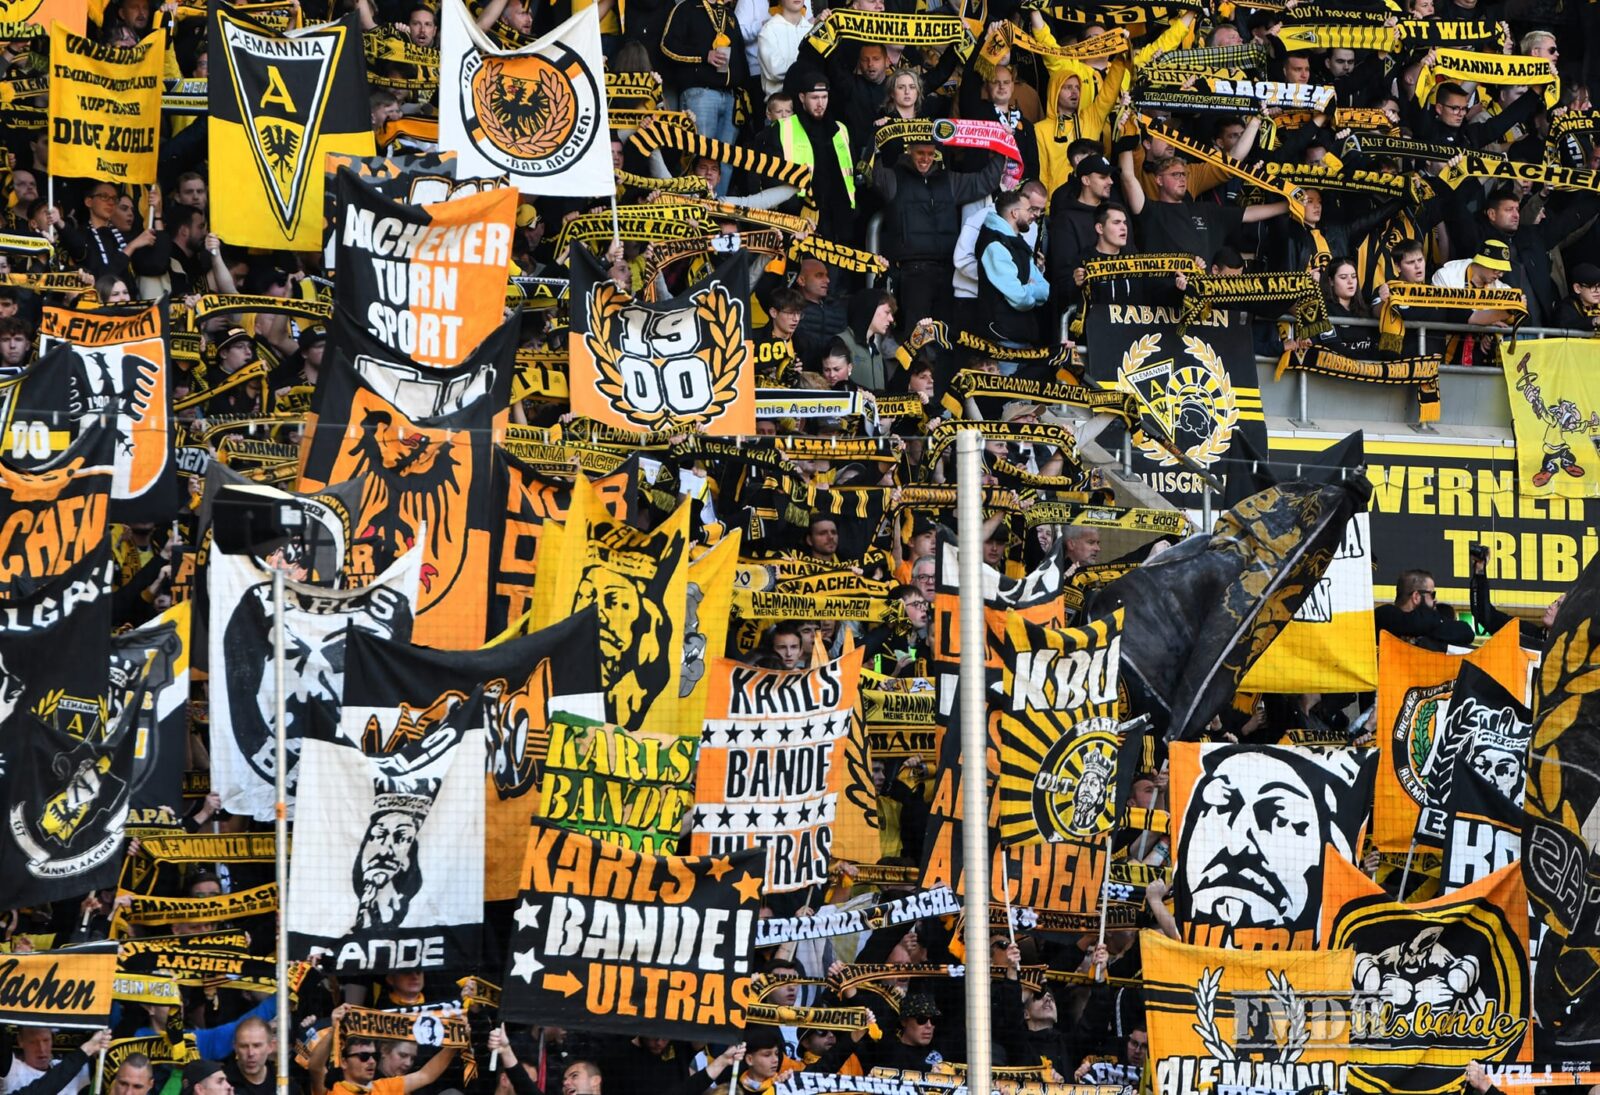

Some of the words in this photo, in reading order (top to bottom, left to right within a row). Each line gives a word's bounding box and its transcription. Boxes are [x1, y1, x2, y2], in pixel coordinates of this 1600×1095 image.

[833, 18, 908, 37] ALEMANNIA
[914, 19, 961, 37] AACHE
[1436, 21, 1492, 40] WILL
[230, 34, 326, 57] ALEMANNIA
[1435, 58, 1504, 76] LEMANNIA
[260, 66, 297, 112] A
[1144, 92, 1250, 107] TRADITIONSVEREIN
[1214, 81, 1335, 107] AACHEN
[105, 125, 154, 154] KOHLE
[907, 123, 933, 135] AACHEN
[966, 127, 990, 139] BAYERN
[1361, 136, 1383, 148] AUF
[1386, 138, 1428, 152] GEDEIH
[1430, 144, 1455, 158] UND
[1353, 170, 1405, 188] PAPA
[1167, 259, 1193, 271] 2004
[372, 257, 458, 312] TURN
[1268, 275, 1314, 293] AACHE
[1409, 287, 1475, 299] ALEMANNIA
[1479, 290, 1522, 303] AACHEN
[367, 301, 462, 360] SPORT
[620, 308, 699, 358] 19
[1131, 364, 1170, 383] ALEMANNIA
[1317, 351, 1383, 376] KAISERSTADT
[1388, 362, 1409, 377] BAD
[619, 357, 714, 413] 00
[977, 375, 1039, 395] ALEMANNIA
[1043, 382, 1090, 402] AACHEN
[1150, 380, 1164, 398] A
[789, 401, 842, 415] Aachen
[877, 402, 906, 414] 2004
[706, 441, 741, 456] never
[746, 446, 776, 465] walk
[752, 592, 816, 610] ALEMANNIA
[754, 608, 780, 618] MEINE
[782, 608, 812, 619] STADT,
[813, 609, 836, 618] MEIN
[837, 609, 870, 619] VEREIN
[729, 660, 842, 716] KARLS
[67, 713, 83, 734] A
[883, 711, 903, 721] MEINE
[546, 722, 694, 785] KARLS
[726, 741, 834, 800] BANDE
[539, 772, 692, 833] BANDE
[143, 838, 248, 858] ALEMANNIA
[518, 826, 700, 905] KARLS
[921, 822, 1103, 913] ACHEN
[891, 886, 960, 925] AACHE
[543, 895, 754, 974] BANDE!
[155, 954, 244, 974] AACHEN
[310, 935, 445, 971] ANDE
[586, 962, 753, 1030] ULTRAS
